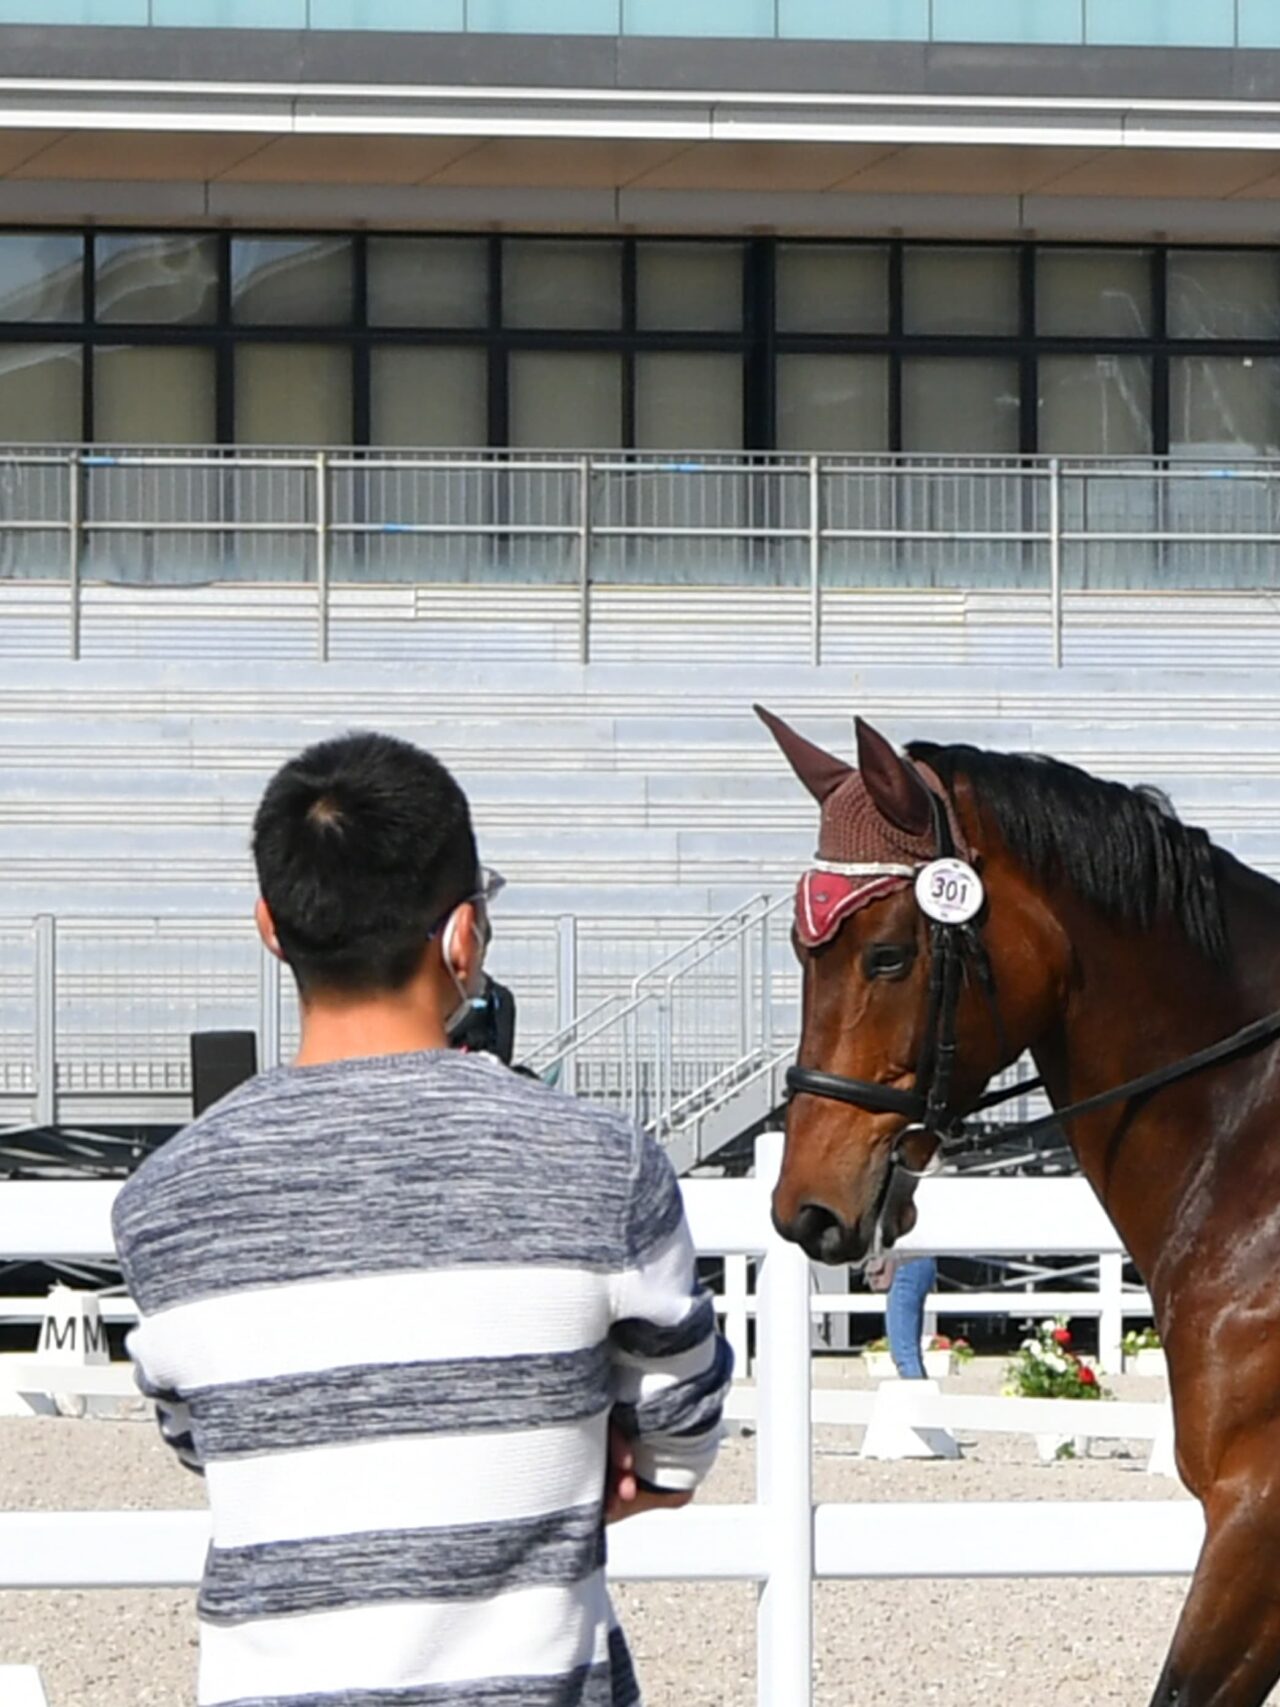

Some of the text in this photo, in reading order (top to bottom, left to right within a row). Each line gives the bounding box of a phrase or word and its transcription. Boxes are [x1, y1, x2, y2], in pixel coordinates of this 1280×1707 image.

[931, 876, 968, 905] 301
[45, 1315, 77, 1351] M
[82, 1314, 109, 1354] M
